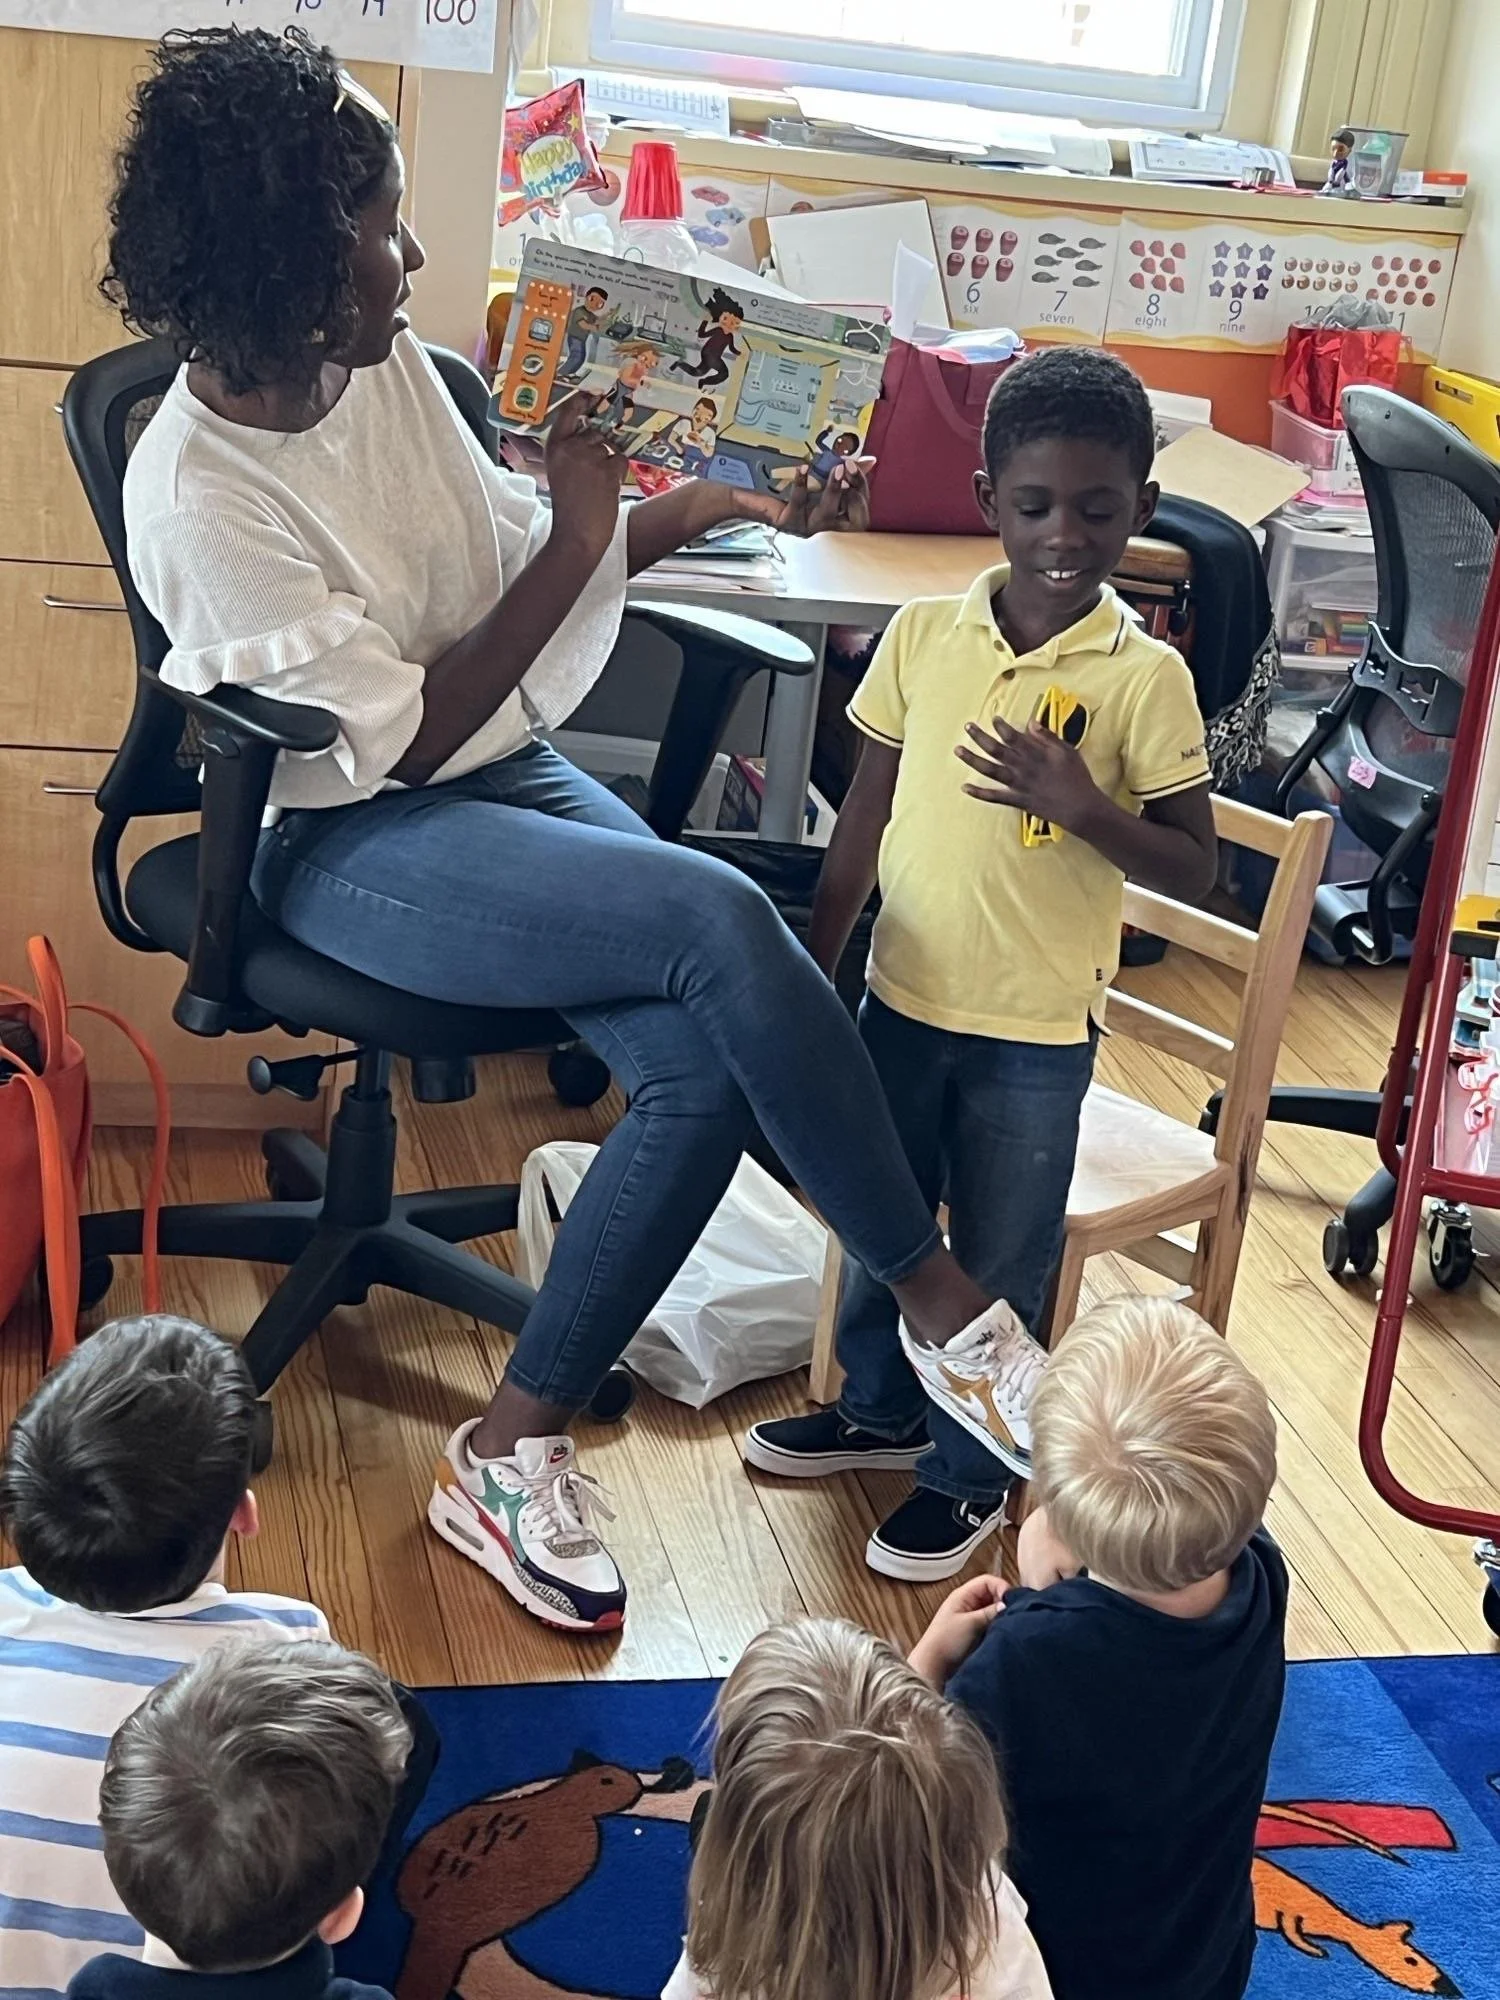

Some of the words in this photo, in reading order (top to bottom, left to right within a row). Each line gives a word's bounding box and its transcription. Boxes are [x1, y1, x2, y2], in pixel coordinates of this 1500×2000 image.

[426, 0, 477, 26] 100
[966, 281, 981, 304] 6
[1053, 290, 1068, 313] 7
[963, 303, 980, 315] six
[1146, 293, 1161, 316] 8
[1228, 299, 1243, 322] 9
[1039, 311, 1076, 325] seven
[1134, 314, 1168, 328] eight
[1219, 319, 1247, 333] nine
